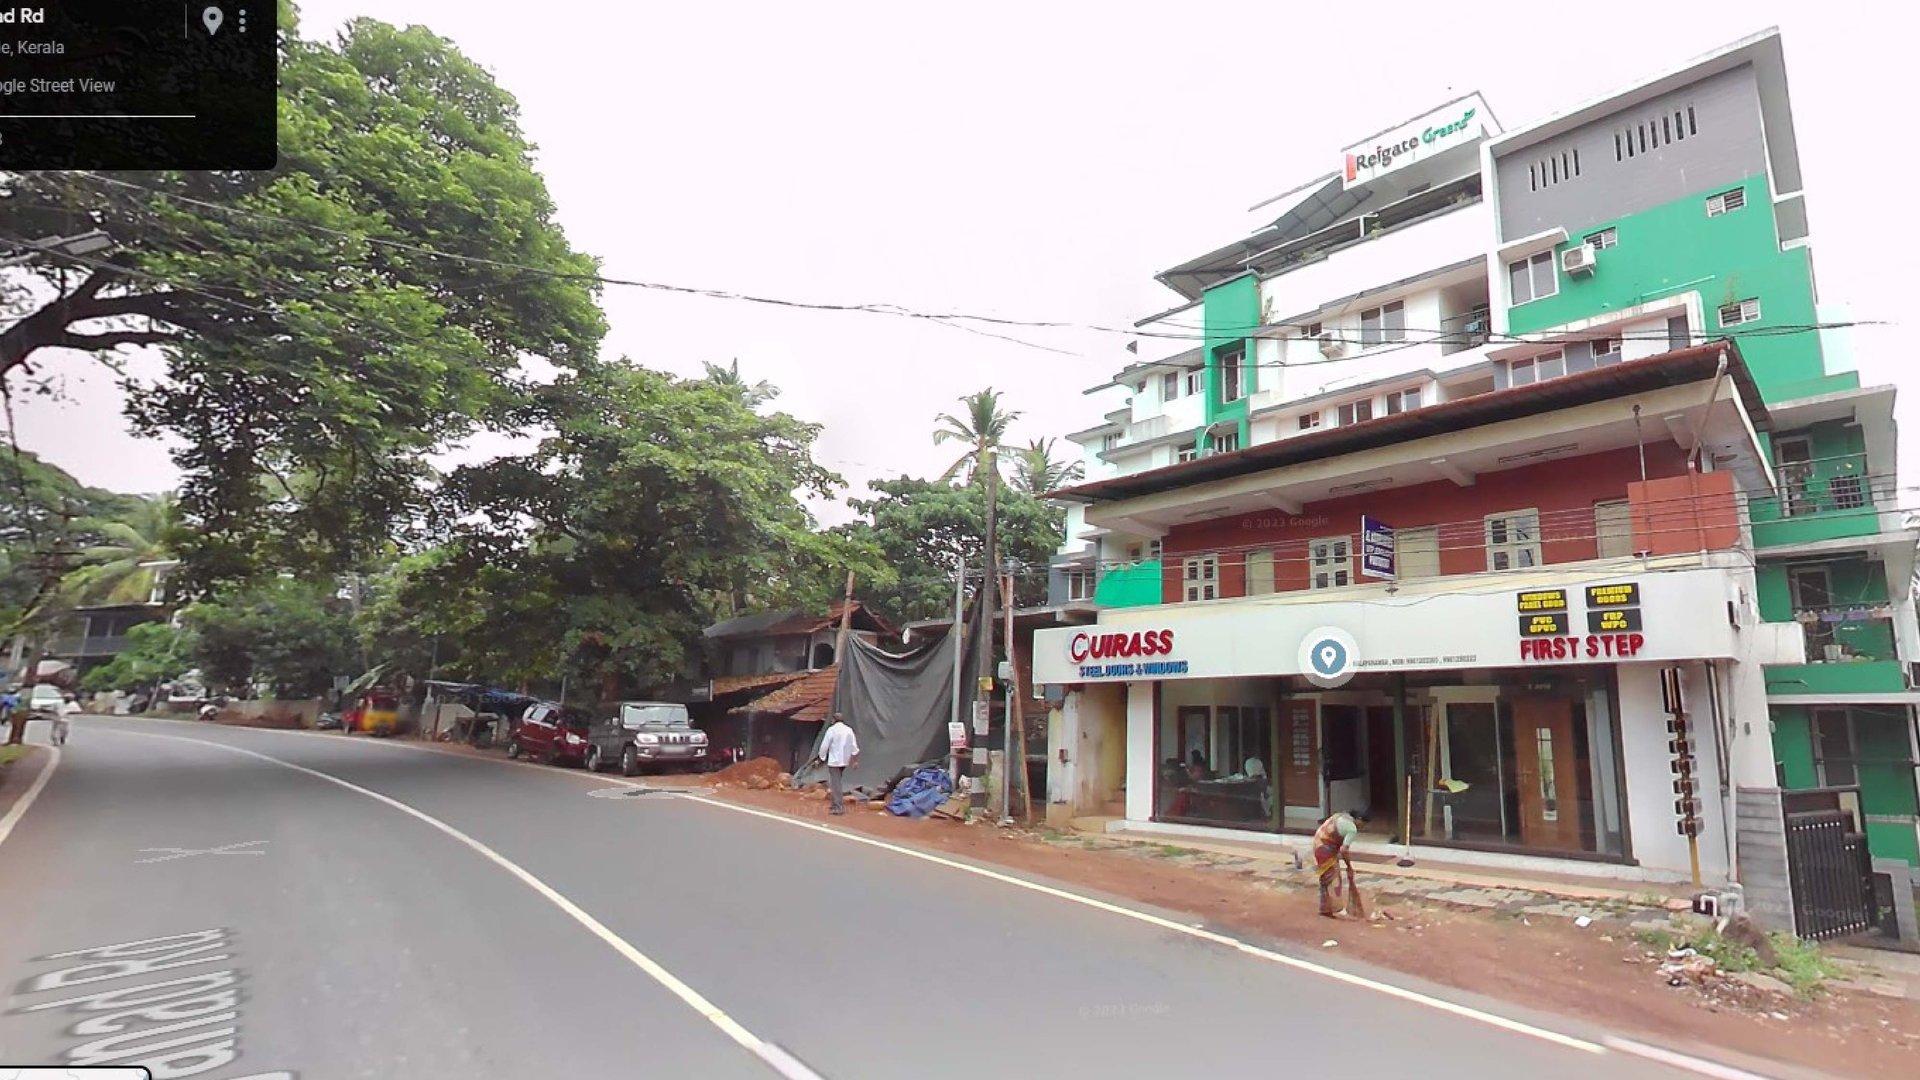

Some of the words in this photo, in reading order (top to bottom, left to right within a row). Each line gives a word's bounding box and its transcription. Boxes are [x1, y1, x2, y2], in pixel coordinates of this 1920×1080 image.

[1356, 136, 1420, 172] Reigate
[1071, 629, 1174, 662] CUIRASS
[1520, 636, 1580, 660] FIRST
[1585, 633, 1644, 658] STEP
[1143, 661, 1188, 674] WINDOWS
